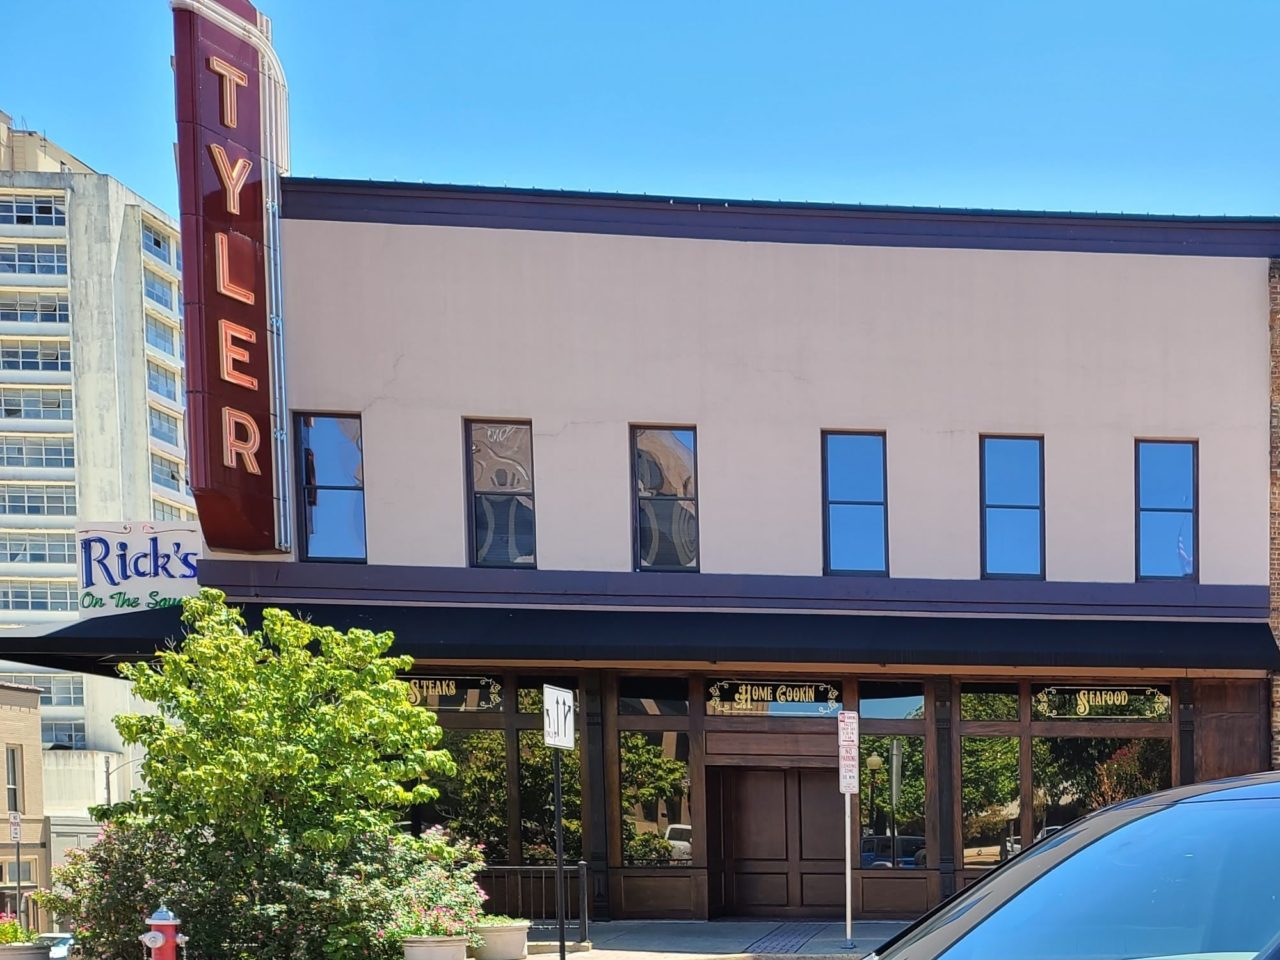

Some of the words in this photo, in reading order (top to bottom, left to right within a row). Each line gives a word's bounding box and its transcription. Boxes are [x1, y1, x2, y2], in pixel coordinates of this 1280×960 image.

[207, 55, 262, 475] TYLER
[80, 535, 198, 589] Rick's
[81, 591, 105, 609] On
[109, 591, 140, 609] The
[408, 679, 457, 706] STEAKS
[734, 684, 773, 708] HOME
[1076, 690, 1128, 715] SEAFOOD
